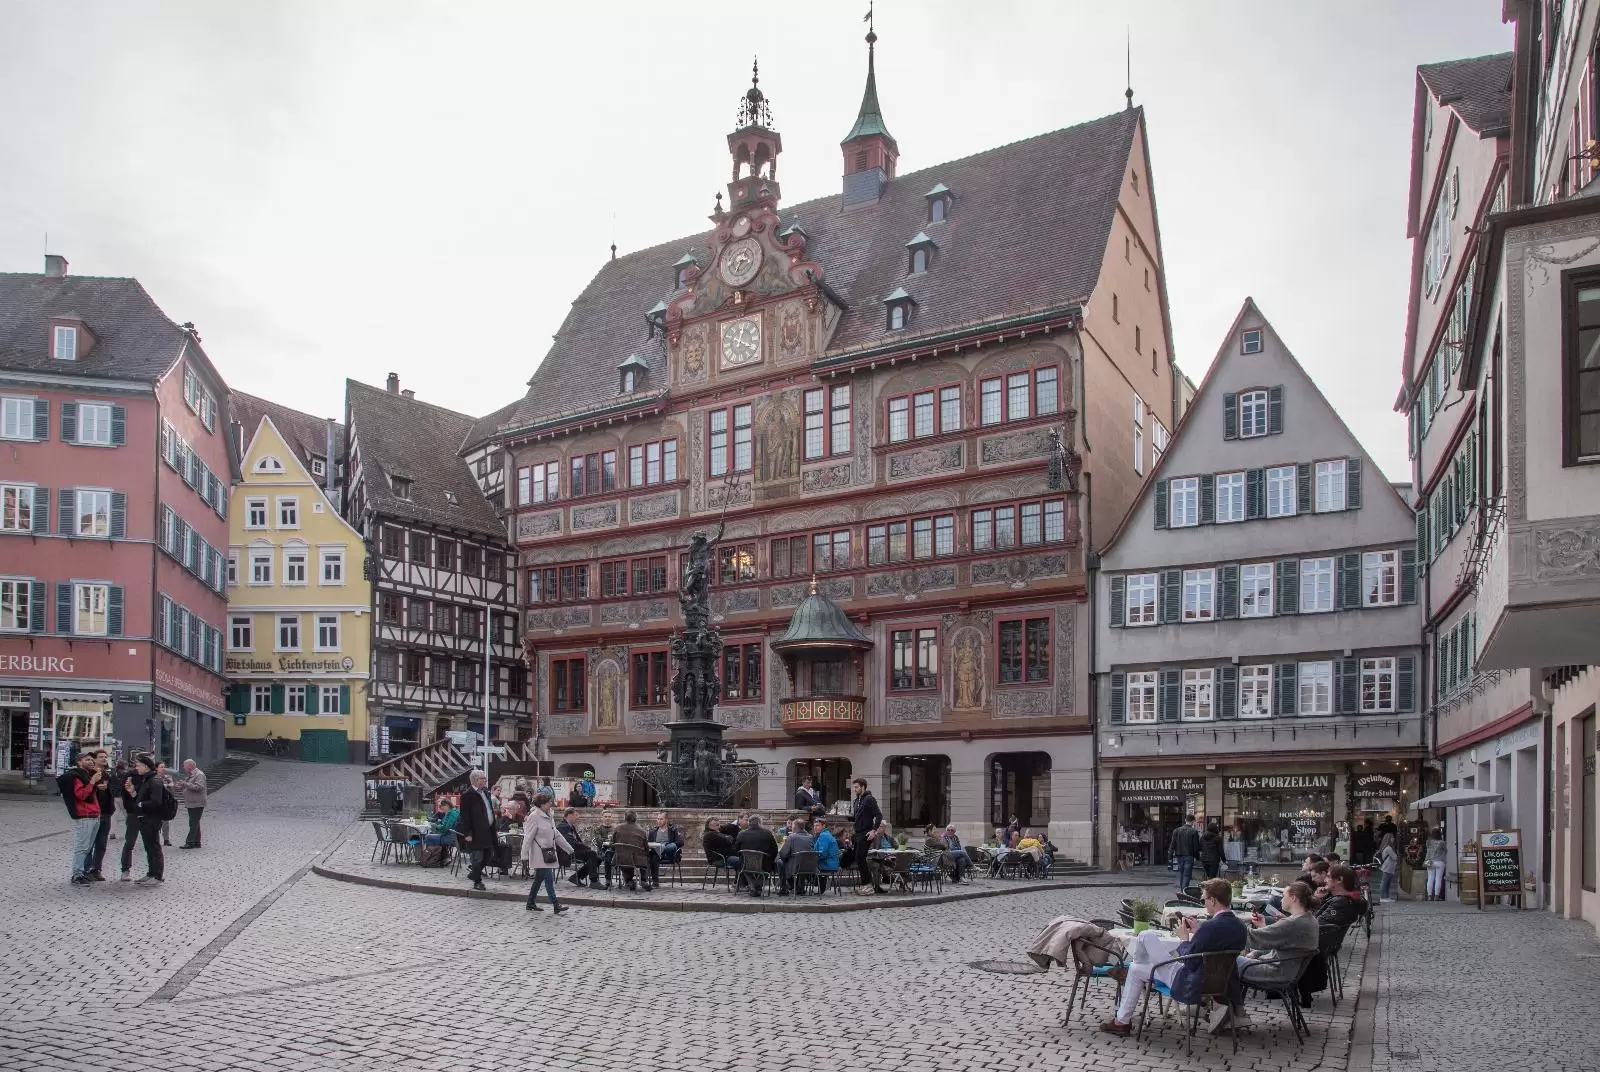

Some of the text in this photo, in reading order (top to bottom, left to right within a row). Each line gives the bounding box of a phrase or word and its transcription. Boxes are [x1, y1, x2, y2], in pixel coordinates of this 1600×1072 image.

[0, 655, 74, 673] ERBURG
[278, 656, 340, 671] Lichtenstein
[1119, 779, 1179, 791] MARQUART
[1228, 776, 1328, 789] GLAS-PORZELLAN
[1290, 819, 1317, 827] Spirits
[1296, 826, 1317, 835] Shop
